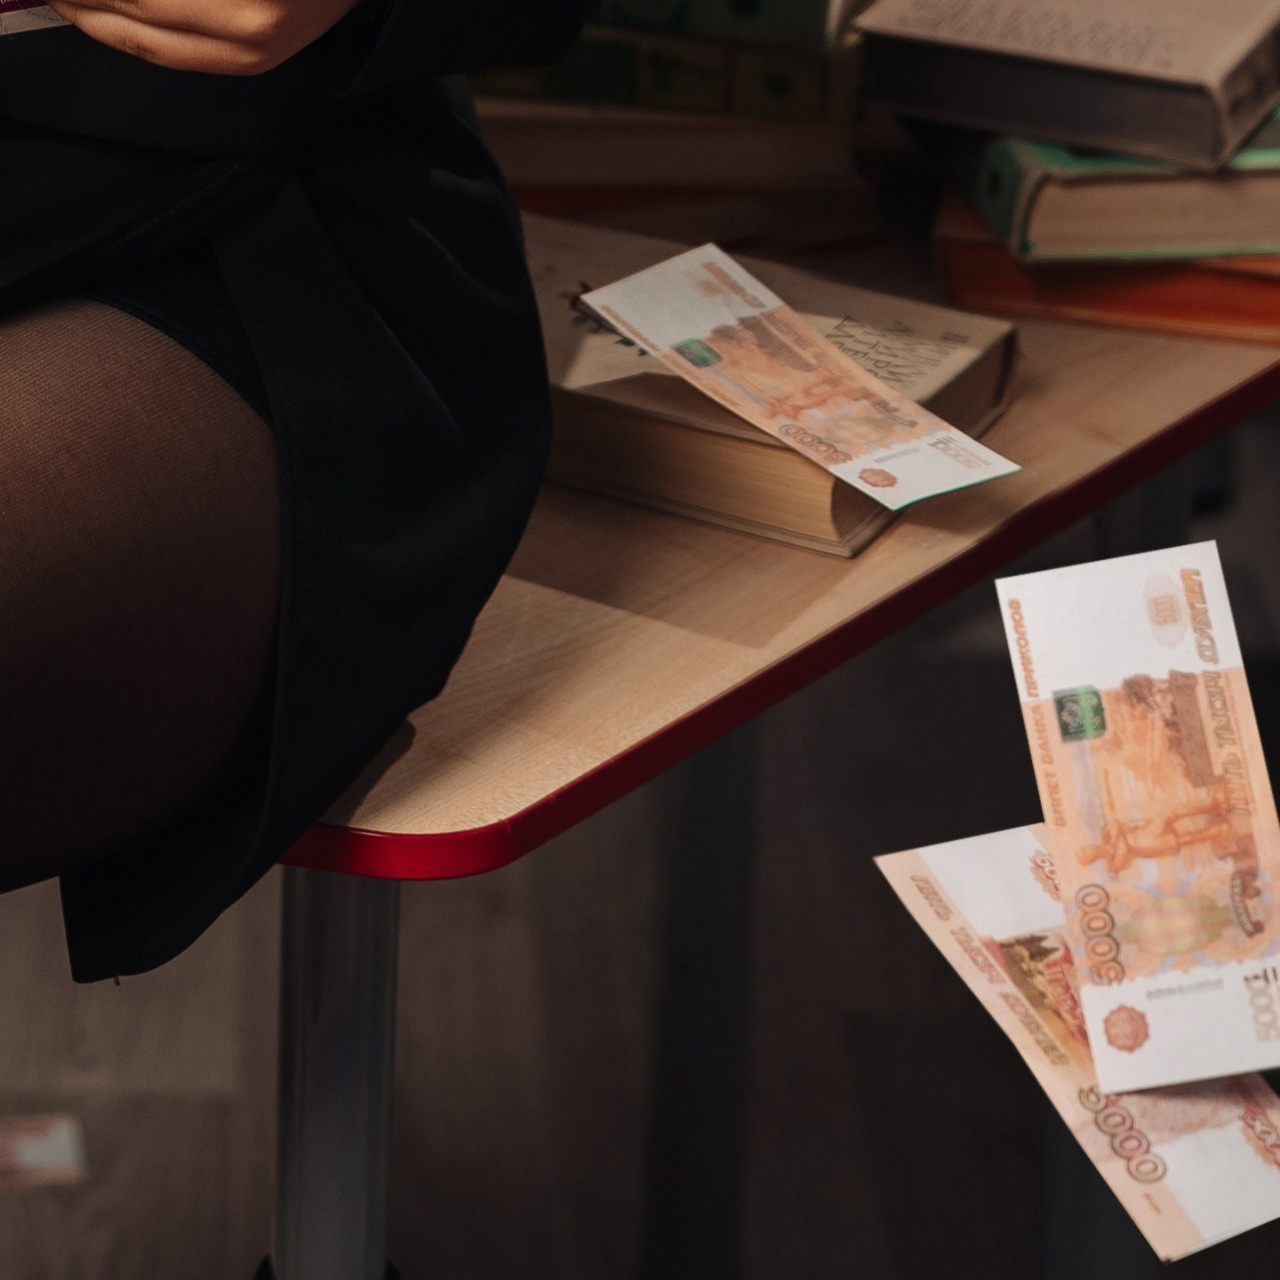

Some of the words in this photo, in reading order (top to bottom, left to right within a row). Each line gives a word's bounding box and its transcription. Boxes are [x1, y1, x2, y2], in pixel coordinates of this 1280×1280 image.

[778, 424, 854, 465] 5000
[1076, 883, 1125, 986] 5000
[1078, 1085, 1167, 1183] 5000
